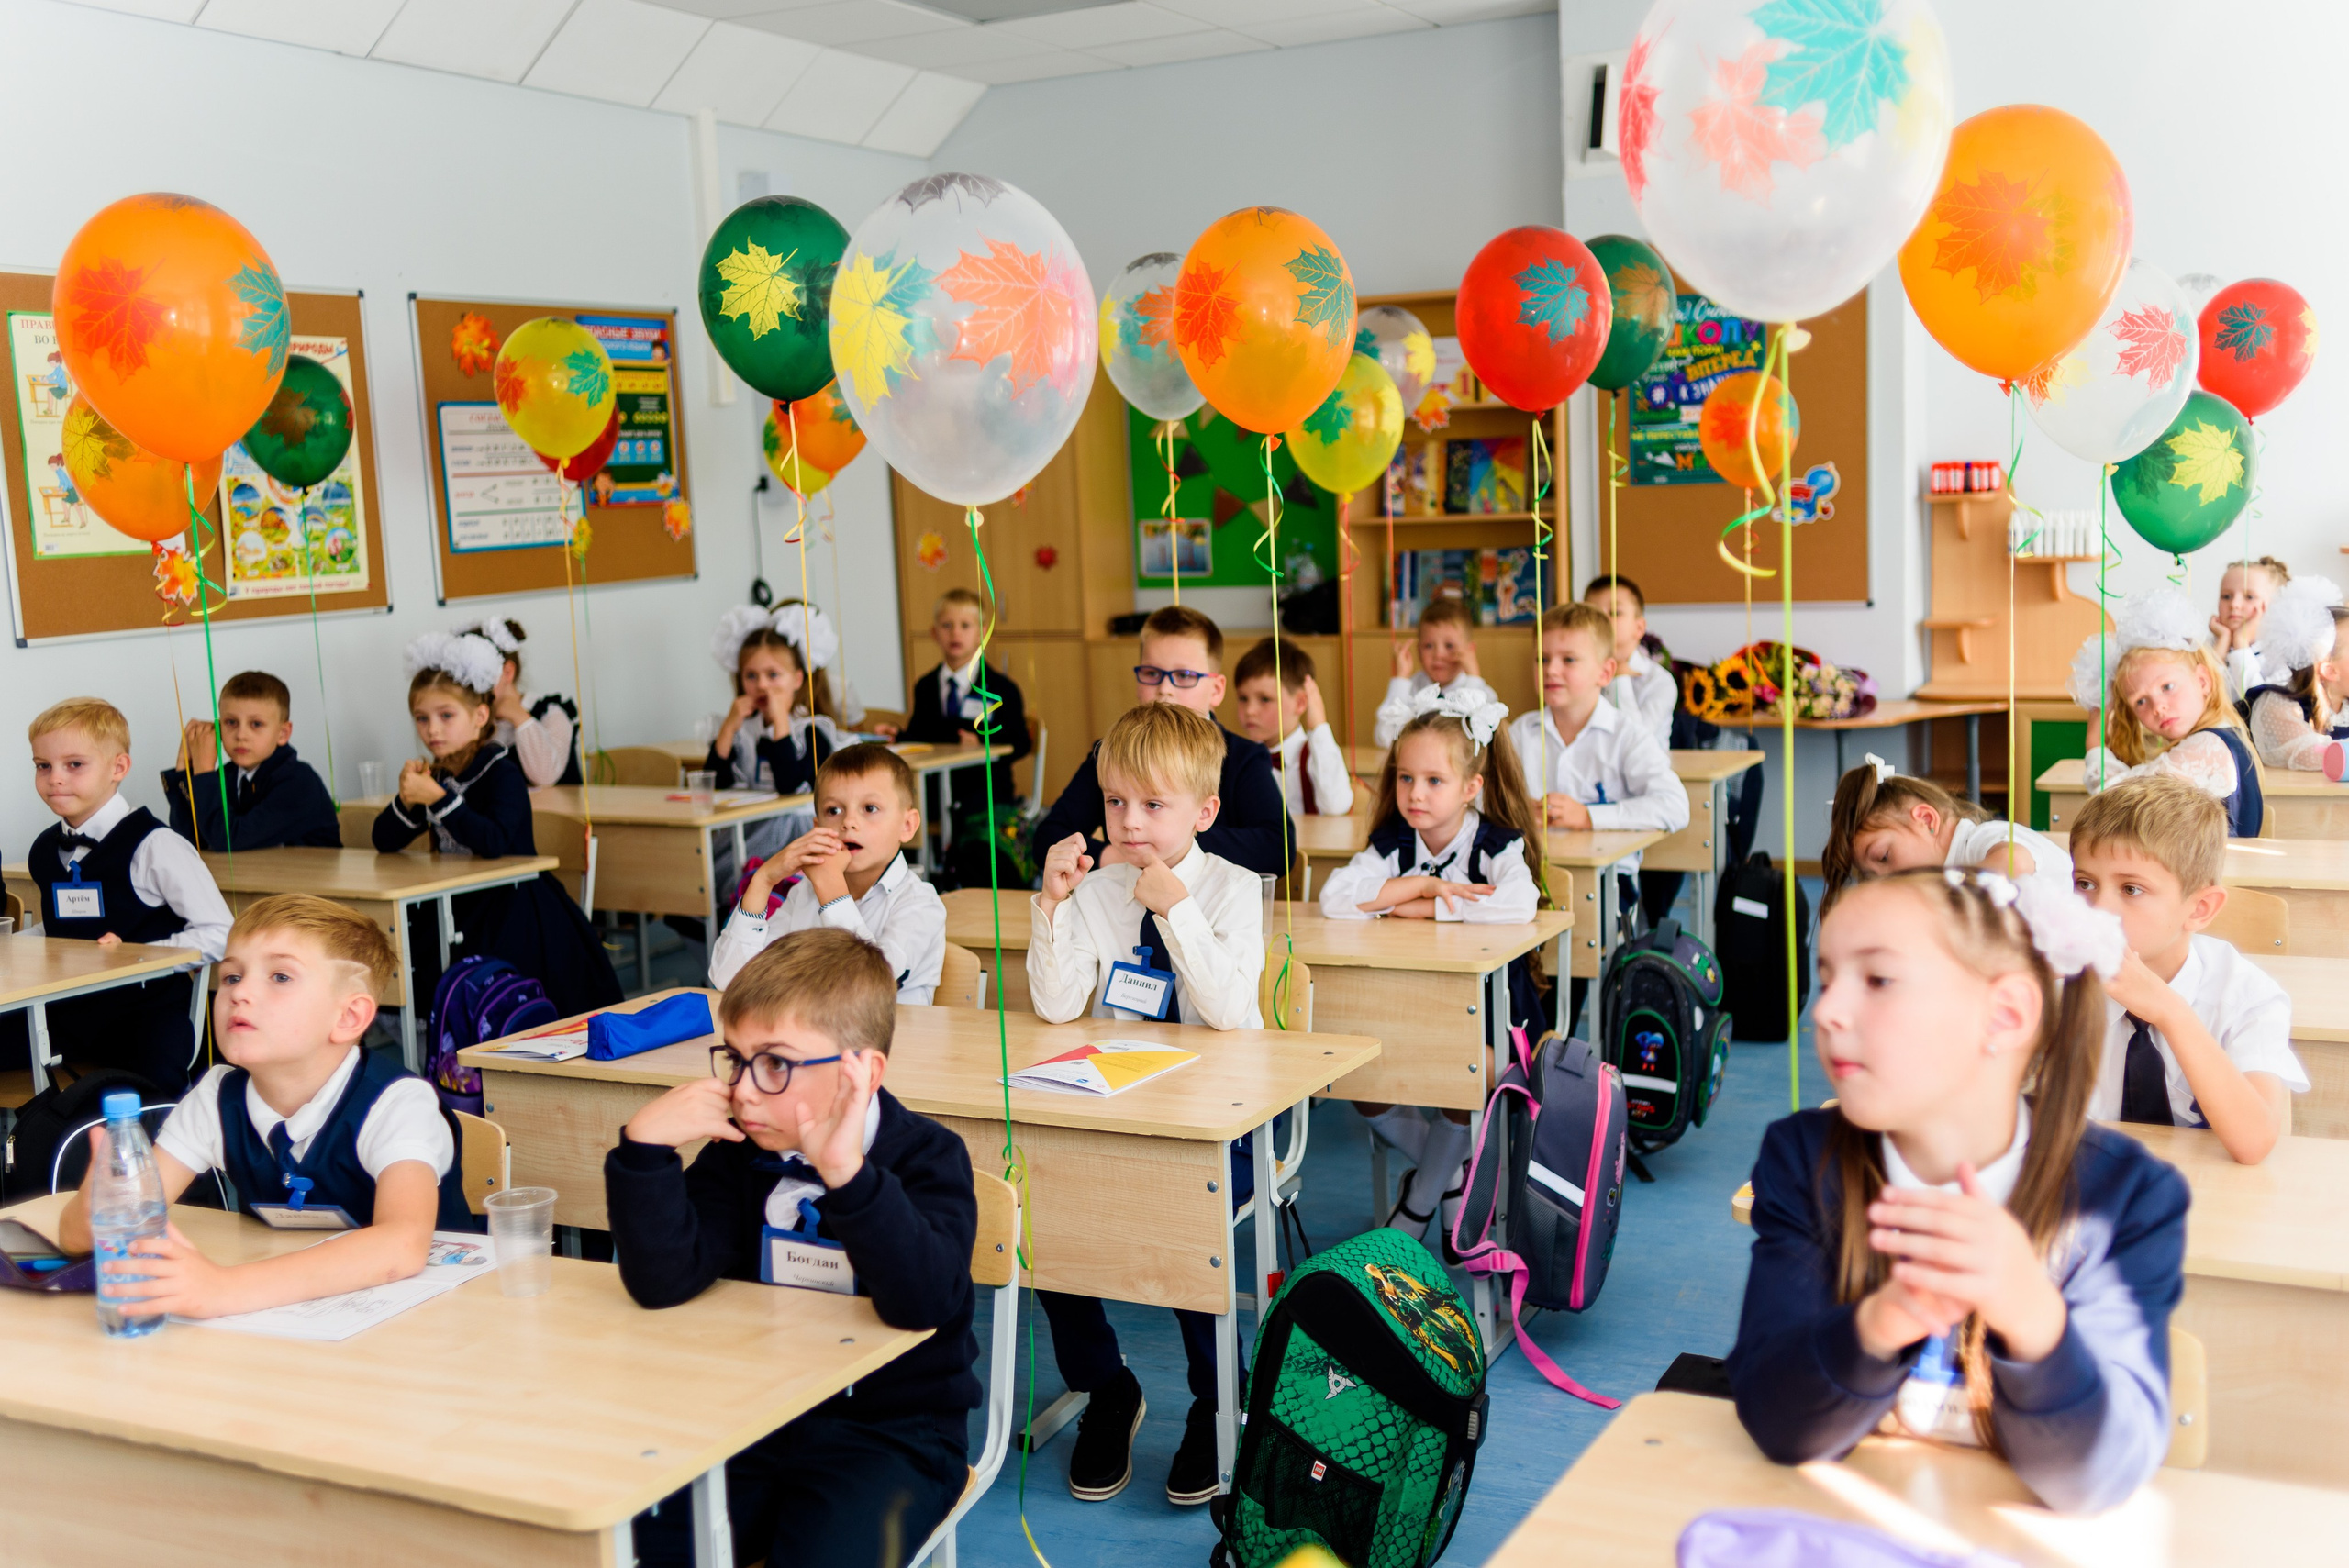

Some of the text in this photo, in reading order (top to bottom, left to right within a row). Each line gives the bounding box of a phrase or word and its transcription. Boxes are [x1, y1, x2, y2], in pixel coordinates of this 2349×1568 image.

[34, 335, 50, 345] ВО
[66, 895, 90, 904] Артём
[786, 1251, 839, 1270] Богдан
